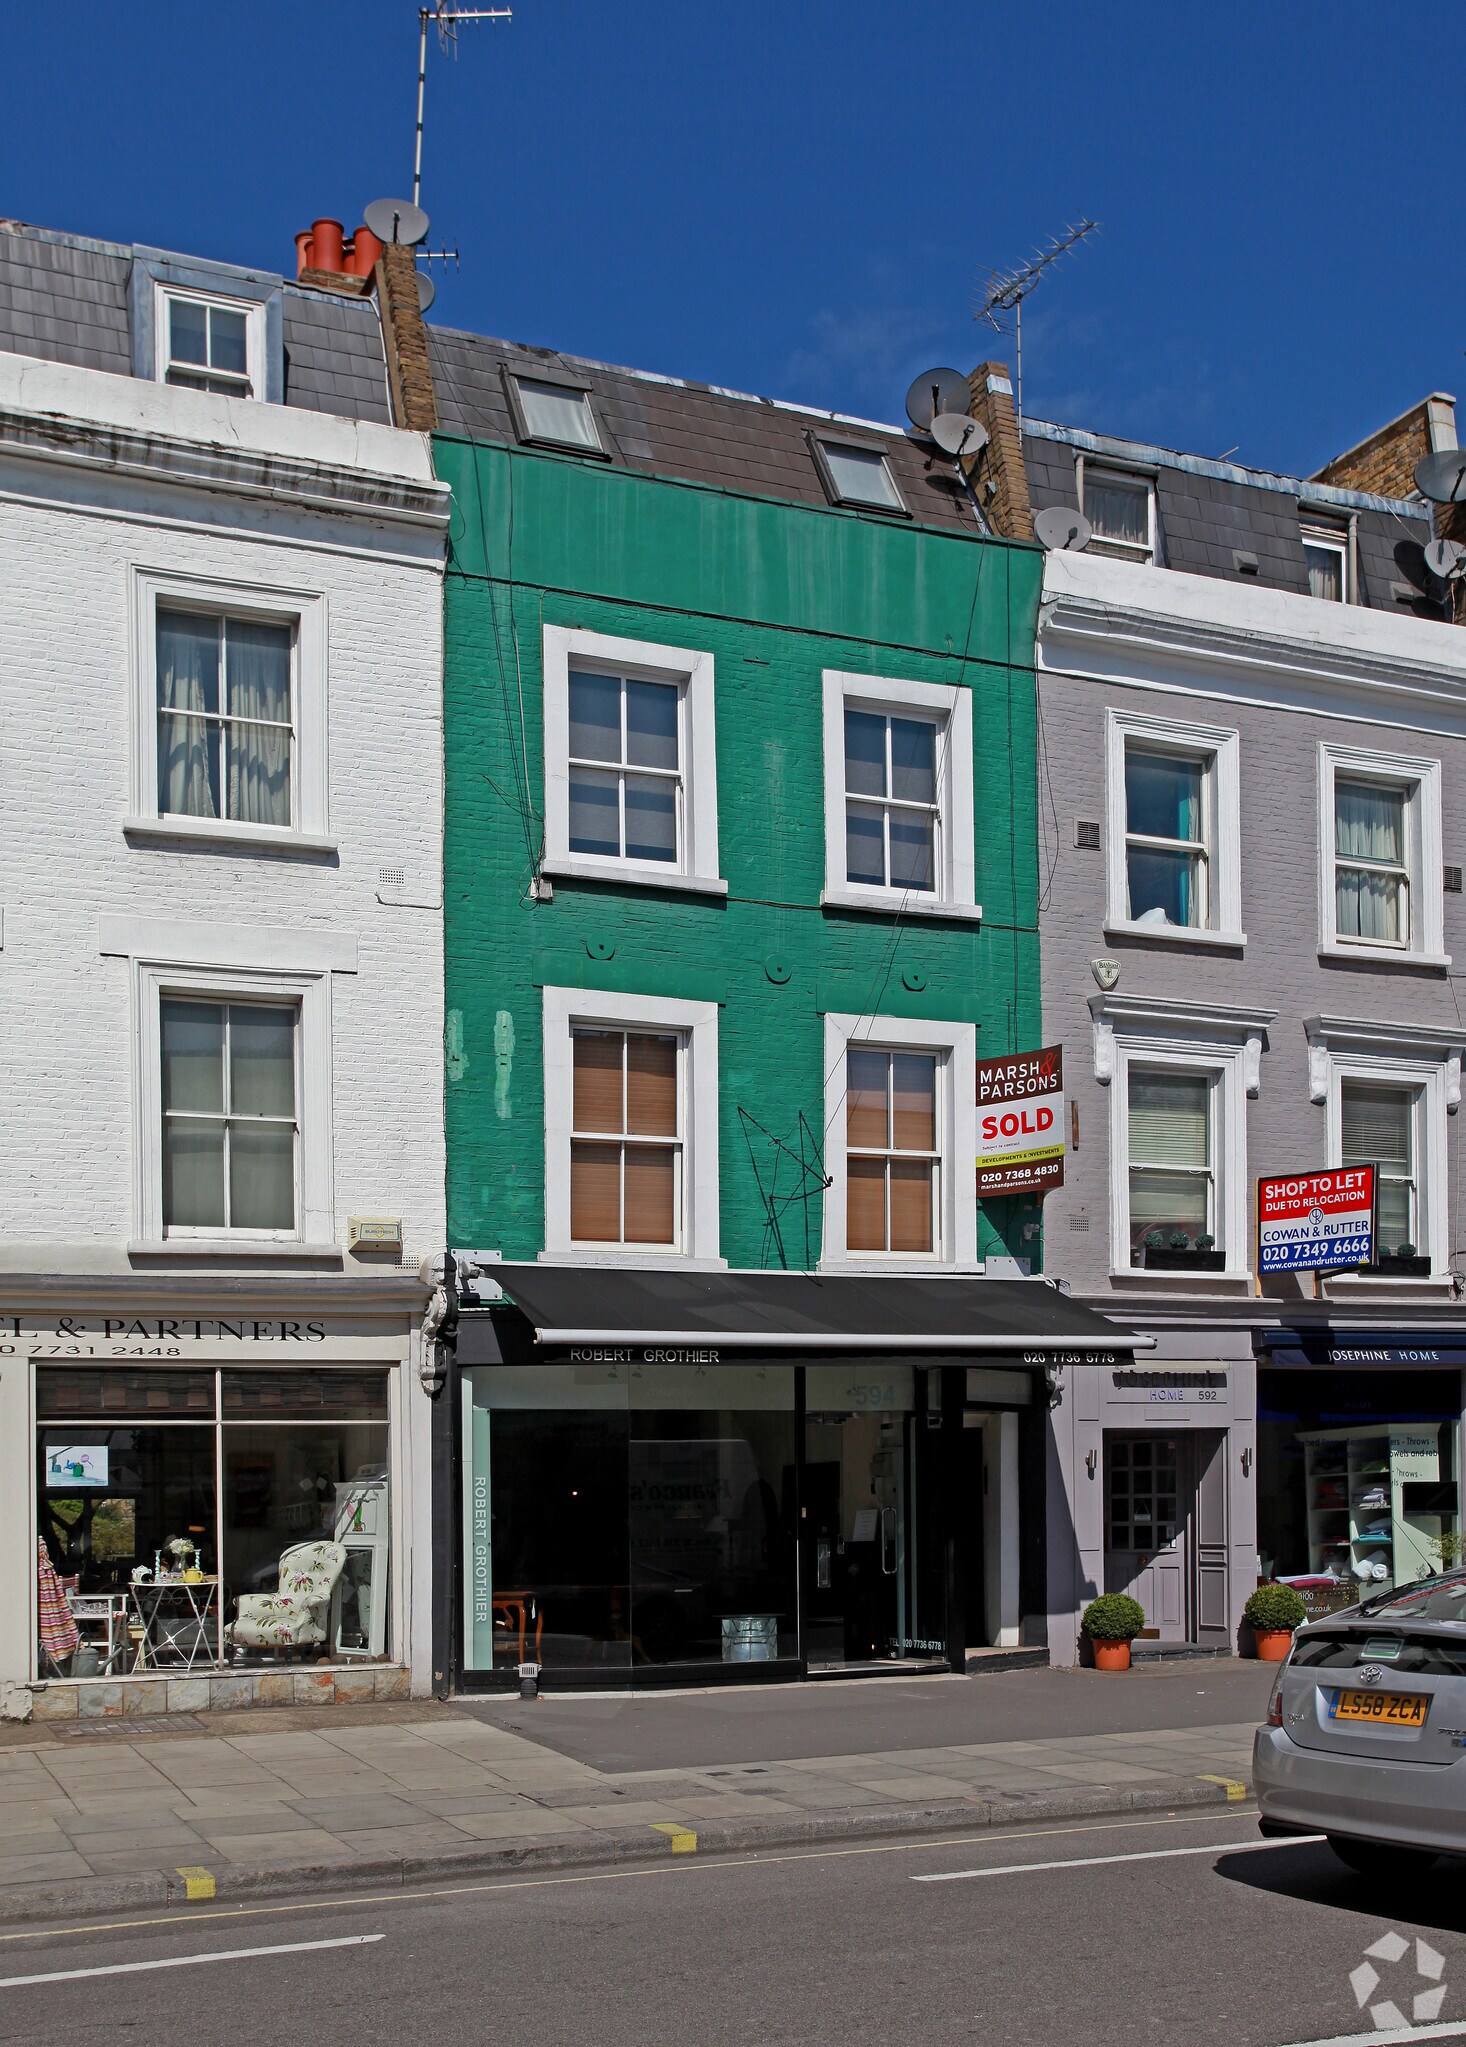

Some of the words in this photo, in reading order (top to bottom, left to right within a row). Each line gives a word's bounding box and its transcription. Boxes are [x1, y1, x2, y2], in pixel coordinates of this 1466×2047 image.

[980, 1060, 1040, 1084] MARSH
[980, 1073, 1058, 1100] PARSONS
[981, 1107, 1054, 1140] SOLD
[981, 1154, 1023, 1164] DEVELOPMENTS
[1028, 1147, 1060, 1158] INVESTMENTS
[980, 1177, 1042, 1190] marshandparsons.co.uk
[981, 1172, 1002, 1183] 020
[1004, 1168, 1032, 1180] 7368
[1033, 1164, 1059, 1176] 4830
[1265, 1181, 1308, 1199] SHOP
[1310, 1177, 1331, 1193] TO
[1336, 1172, 1366, 1190] LET
[1265, 1202, 1286, 1212] DUE
[1286, 1199, 1301, 1209] TO
[1302, 1190, 1365, 1207] RELOCATION
[1263, 1227, 1310, 1242] COWAN
[1312, 1226, 1320, 1237] &
[1323, 1220, 1369, 1236] RUTTER
[1262, 1246, 1289, 1262] 020
[1293, 1242, 1329, 1259] 7349
[1333, 1237, 1370, 1255] 6666
[1262, 1252, 1370, 1271] www.cowanandrutter.co.uk
[55, 1317, 87, 1339] &
[101, 1318, 327, 1343] PARTNERS
[28, 1345, 95, 1356] 7731
[111, 1346, 181, 1357] 2448
[570, 1348, 634, 1362] ROBERT
[643, 1349, 720, 1363] GROTHIER
[1023, 1352, 1046, 1363] 020
[1051, 1352, 1081, 1363] 7736
[1085, 1352, 1115, 1363] 6778
[1327, 1349, 1392, 1362] JOSEPHINE
[1398, 1350, 1440, 1361] HOME
[855, 1384, 895, 1405] 594
[1149, 1390, 1184, 1400] HOME
[1198, 1390, 1217, 1401] 592
[1407, 1437, 1430, 1446] Throws
[1410, 1449, 1424, 1458] and
[475, 1477, 487, 1538] ROBERT
[475, 1545, 487, 1623] GROTHIER
[902, 1639, 913, 1648] 020
[913, 1640, 927, 1649] 7736
[927, 1641, 942, 1651] 6778
[1340, 1694, 1382, 1716] LS58
[1387, 1696, 1420, 1720] ZCA
